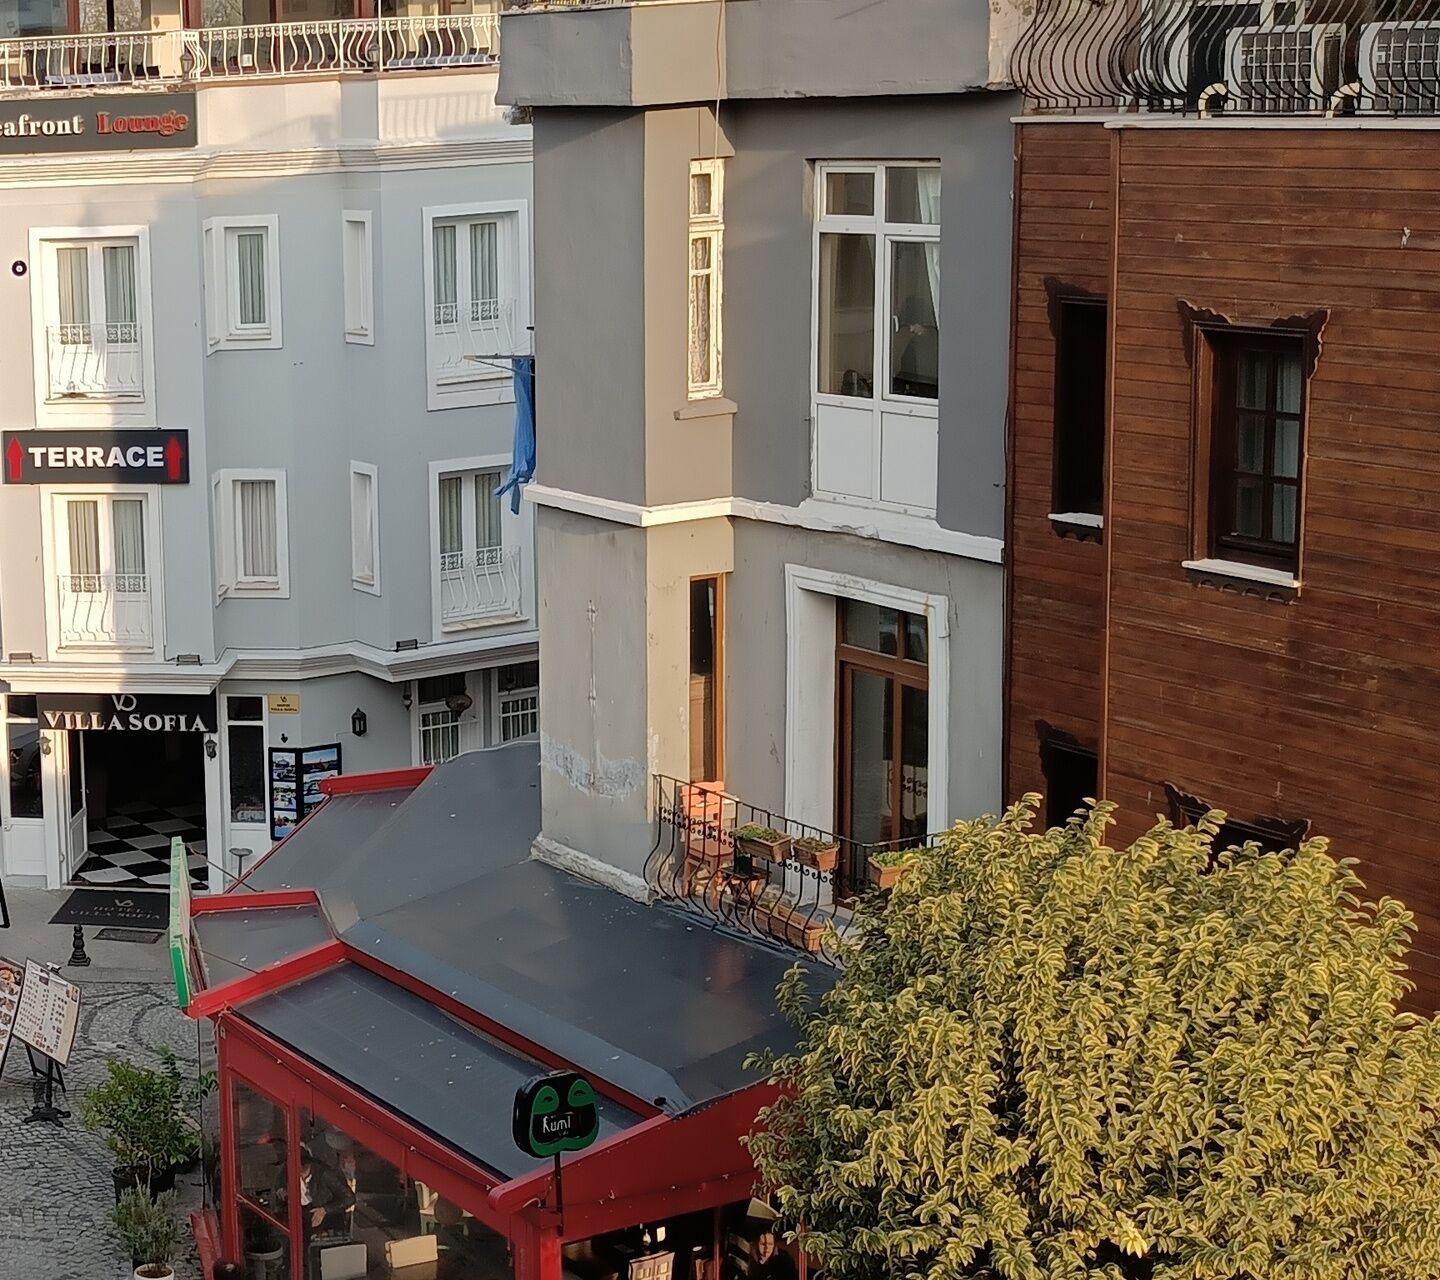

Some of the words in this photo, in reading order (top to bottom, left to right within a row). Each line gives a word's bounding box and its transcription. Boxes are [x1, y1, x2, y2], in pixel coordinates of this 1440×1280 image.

[96, 110, 189, 135] Lounge
[28, 445, 165, 468] TERRACE
[42, 710, 126, 731] VILLA
[128, 713, 209, 732] SOFIA
